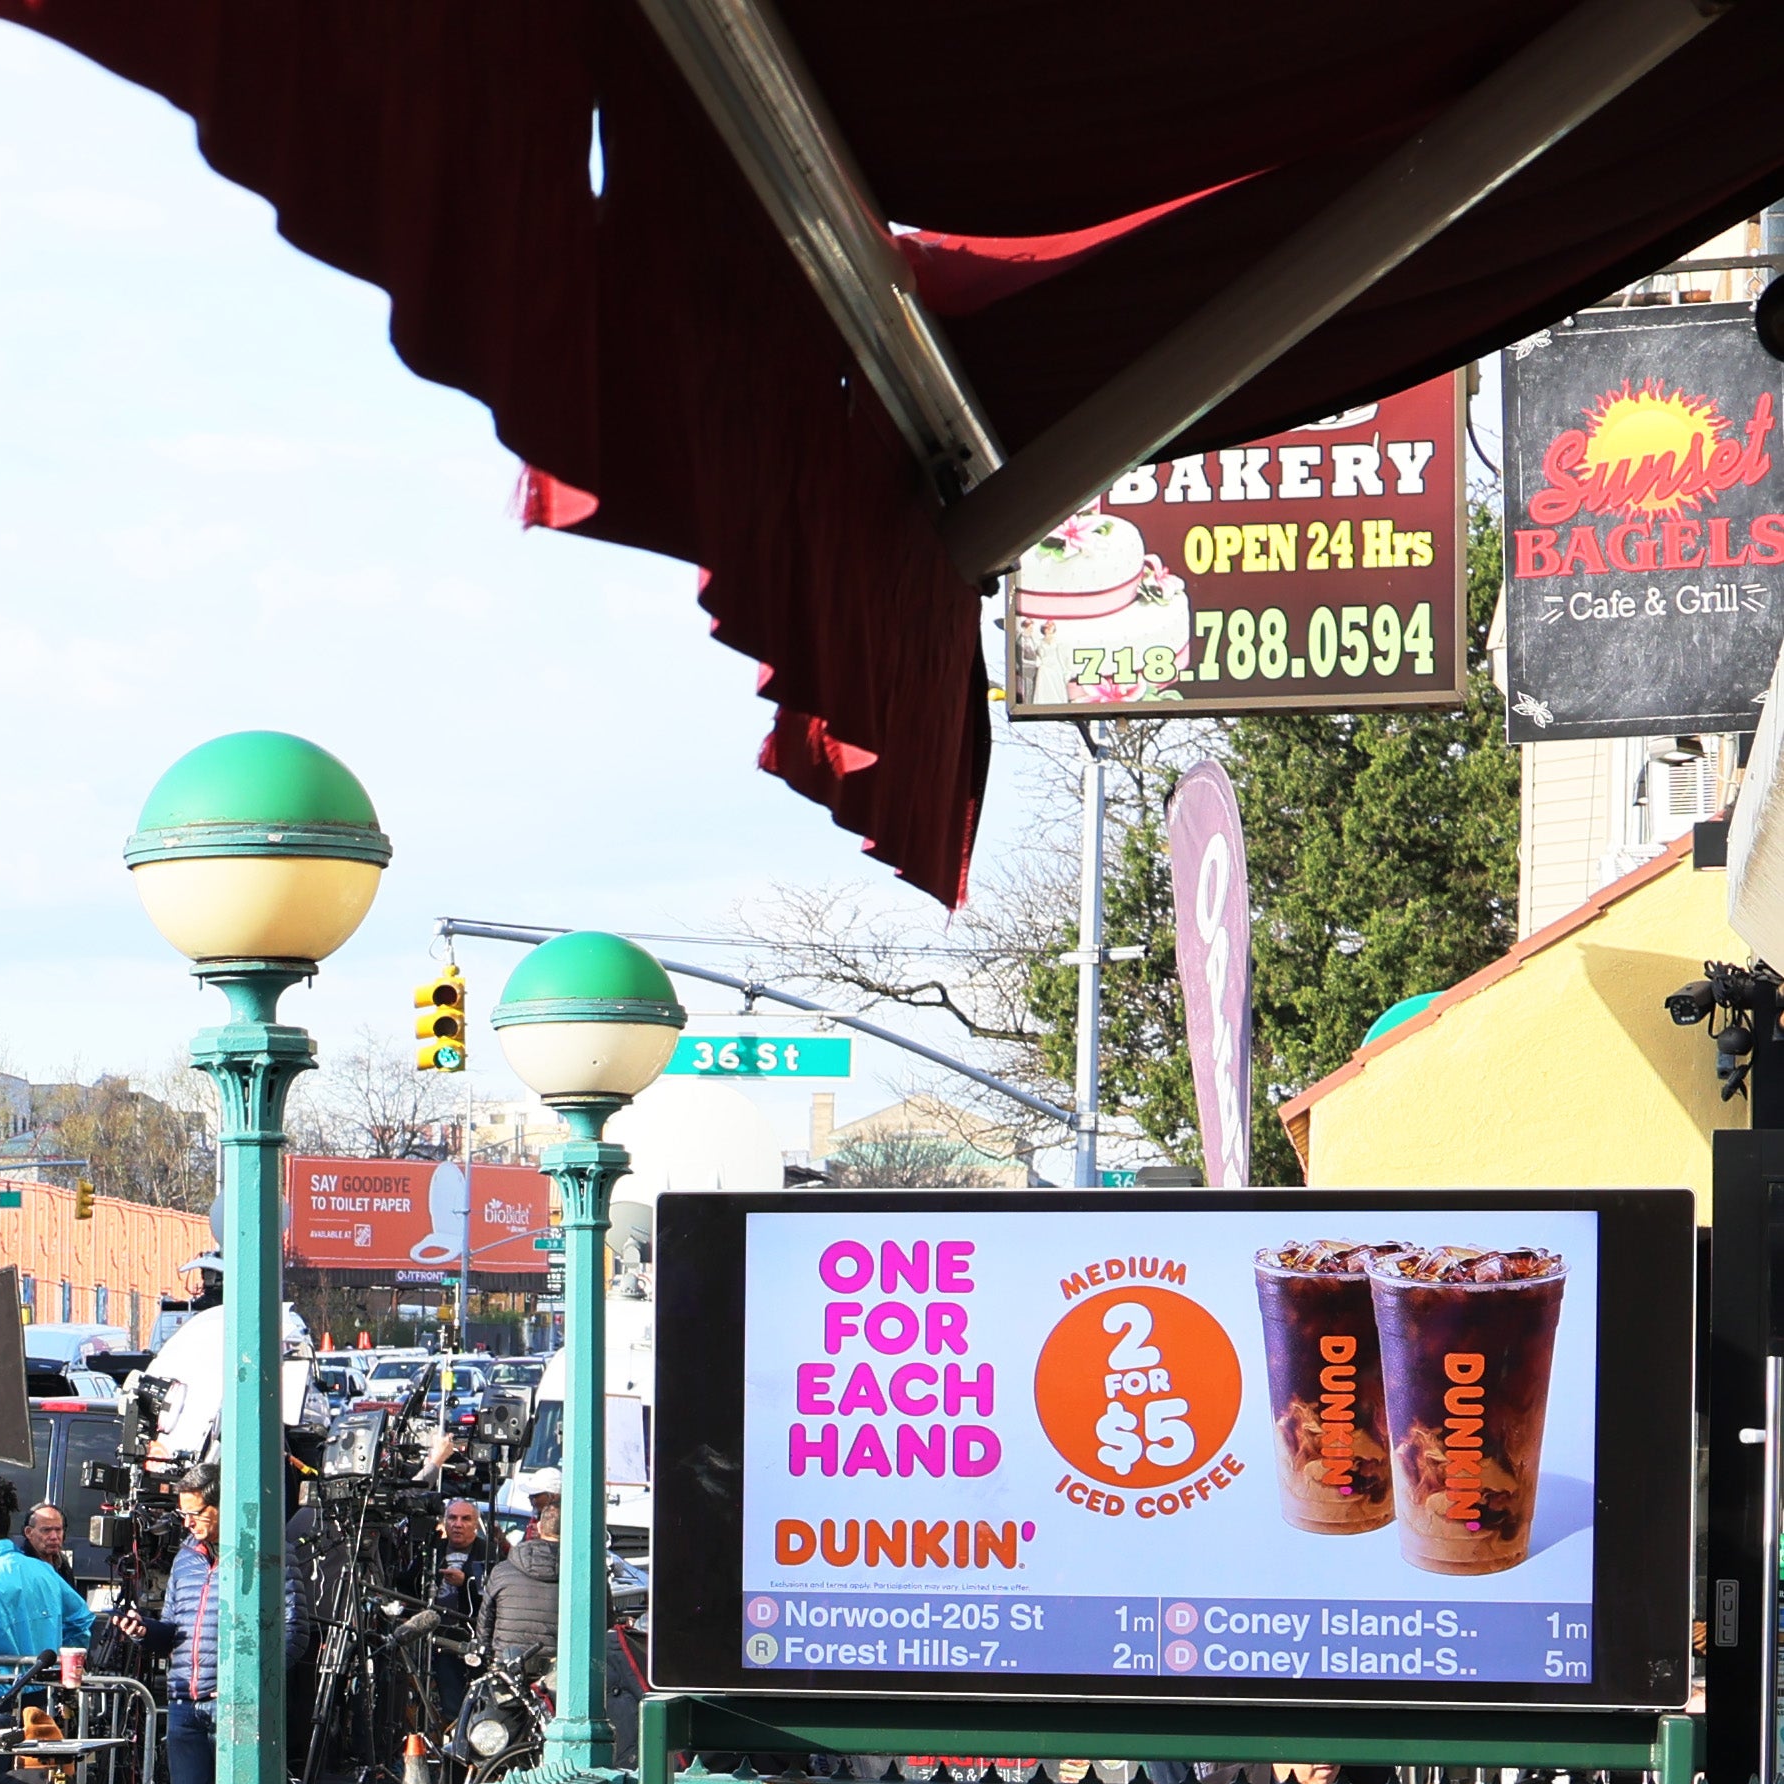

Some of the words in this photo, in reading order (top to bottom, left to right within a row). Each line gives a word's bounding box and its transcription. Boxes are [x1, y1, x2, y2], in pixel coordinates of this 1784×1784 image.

[1107, 438, 1433, 504] BAKERY
[1529, 391, 1775, 525] Sunset
[1184, 524, 1299, 575] OPEN
[1306, 521, 1355, 570] 24
[1361, 519, 1434, 568] Hrs
[1513, 511, 1784, 580] BAGELS
[1569, 587, 1636, 621] Cafe
[1644, 588, 1667, 617] &
[1676, 583, 1740, 616] Grill
[1074, 602, 1435, 686] 718.788.0594
[692, 1042, 740, 1071] 36
[758, 1041, 800, 1072] St
[310, 1174, 337, 1192] SAY
[341, 1175, 411, 1194] GOODBYE
[310, 1195, 325, 1210] TO
[329, 1196, 370, 1212] TOILET
[373, 1198, 411, 1213] PAPER
[309, 1230, 342, 1239] AVAILABLE
[344, 1231, 352, 1239] AT
[396, 1270, 447, 1282] OUTFRONT
[819, 1240, 975, 1294] ONE
[1059, 1256, 1187, 1301] MEDIUM
[824, 1301, 968, 1355] FOR
[1102, 1302, 1161, 1371] 2
[796, 1362, 995, 1417] EACH
[1104, 1368, 1171, 1399] FOR
[788, 1423, 1002, 1477] HAND
[1095, 1398, 1195, 1476] $5
[1054, 1474, 1125, 1518] ICED
[1134, 1453, 1245, 1519] COFFEE
[774, 1518, 1036, 1569] DUNKIN'
[770, 1580, 808, 1588] Exclusions
[849, 1582, 871, 1591] apply.
[873, 1582, 923, 1591] Participation
[756, 1606, 771, 1621] D
[785, 1601, 1000, 1630] Norwood-205
[1010, 1603, 1044, 1630] St
[1114, 1606, 1154, 1632] 1m
[1175, 1610, 1190, 1627] D
[1204, 1606, 1310, 1640] Coney
[1321, 1608, 1478, 1638] Island-S..
[1545, 1612, 1588, 1639] 1m
[1722, 1585, 1733, 1641] PULL
[754, 1641, 769, 1656] R
[785, 1638, 887, 1666] Forest
[897, 1638, 1018, 1667] Hills-7..
[1112, 1643, 1154, 1670] 2m
[1175, 1649, 1190, 1665] D
[1204, 1644, 1310, 1679] Coney
[1321, 1646, 1478, 1676] Island-S..
[1544, 1650, 1588, 1678] 5m
[966, 1768, 978, 1782] &
